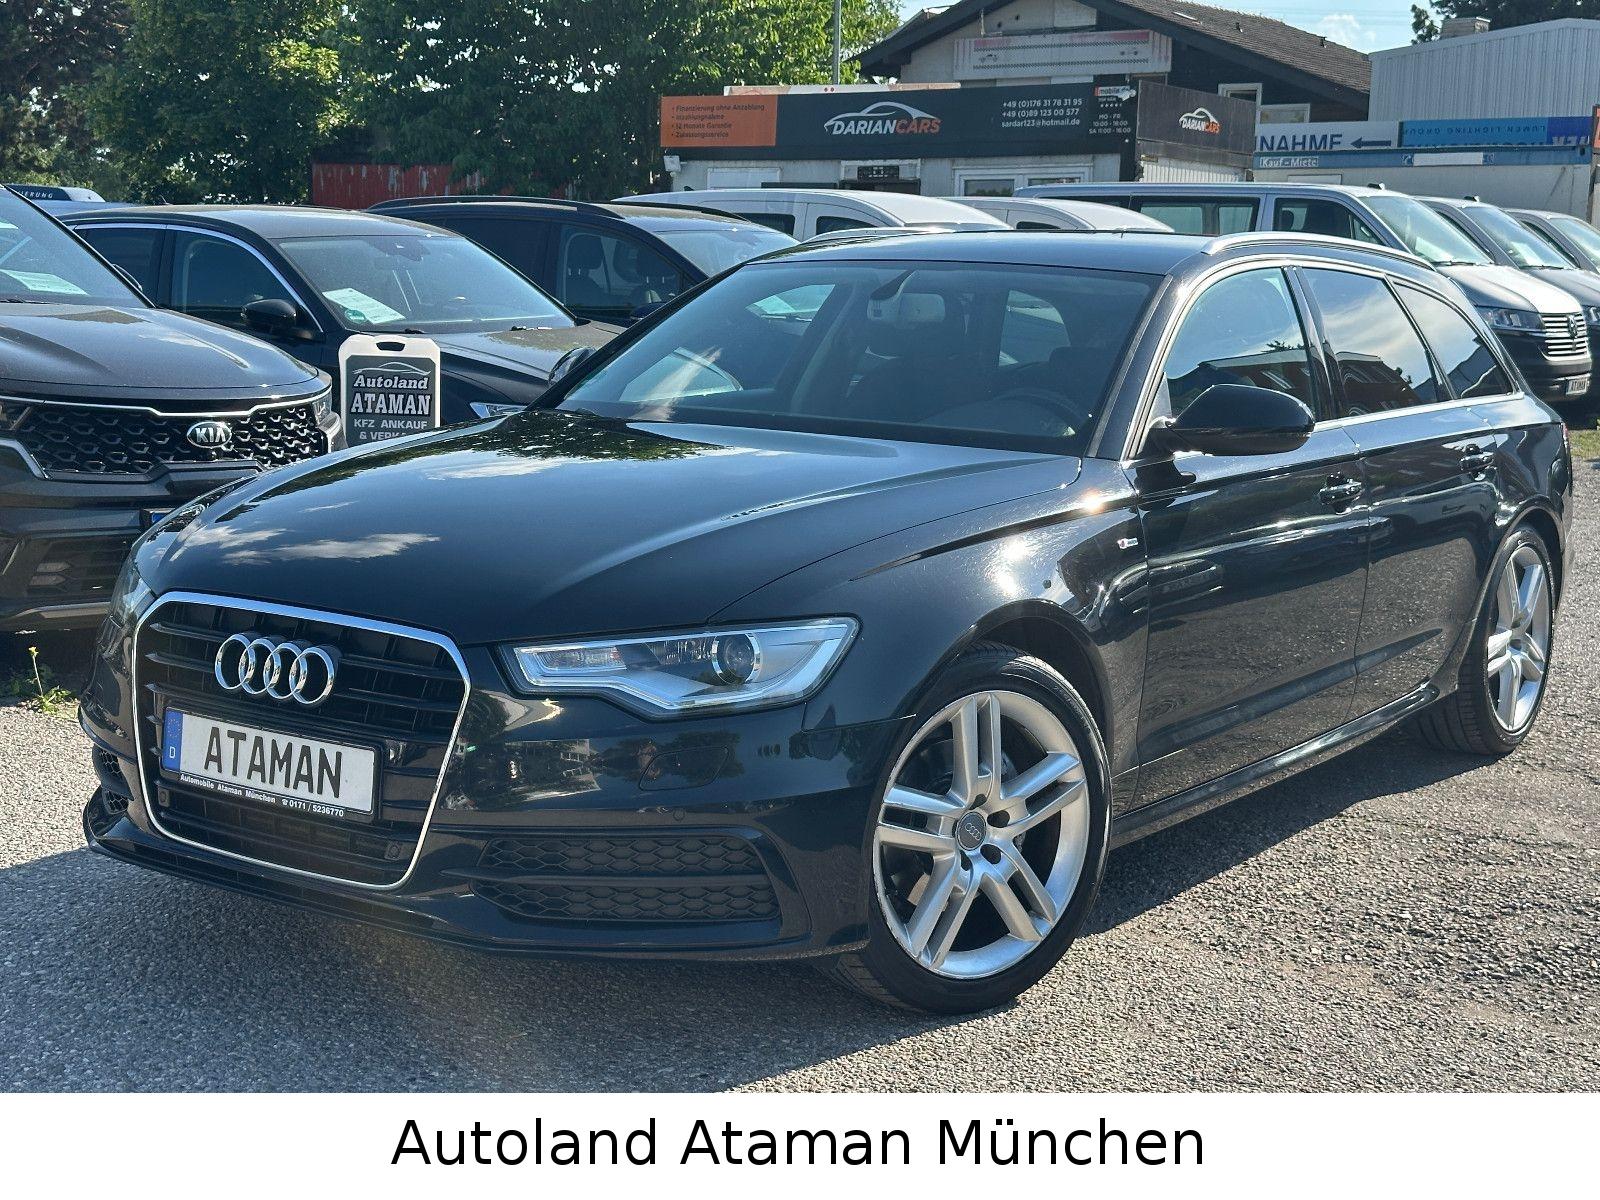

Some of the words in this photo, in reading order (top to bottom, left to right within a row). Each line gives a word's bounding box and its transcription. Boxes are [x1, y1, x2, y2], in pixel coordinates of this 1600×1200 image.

[1040, 109, 1052, 117] 123
[1053, 108, 1064, 116] 00
[353, 375, 428, 390] Autoland
[351, 392, 431, 415] ATAMAN
[354, 418, 375, 428] KFZ
[381, 419, 428, 430] ANKAUF
[195, 427, 226, 443] KIA
[360, 431, 367, 440] &
[169, 746, 176, 759] D
[203, 726, 343, 799] ATAMAN
[180, 773, 215, 789] Automobile
[217, 783, 242, 796] Ataman
[245, 789, 276, 803] München
[289, 799, 306, 810] 0171
[312, 804, 344, 817] 5236770
